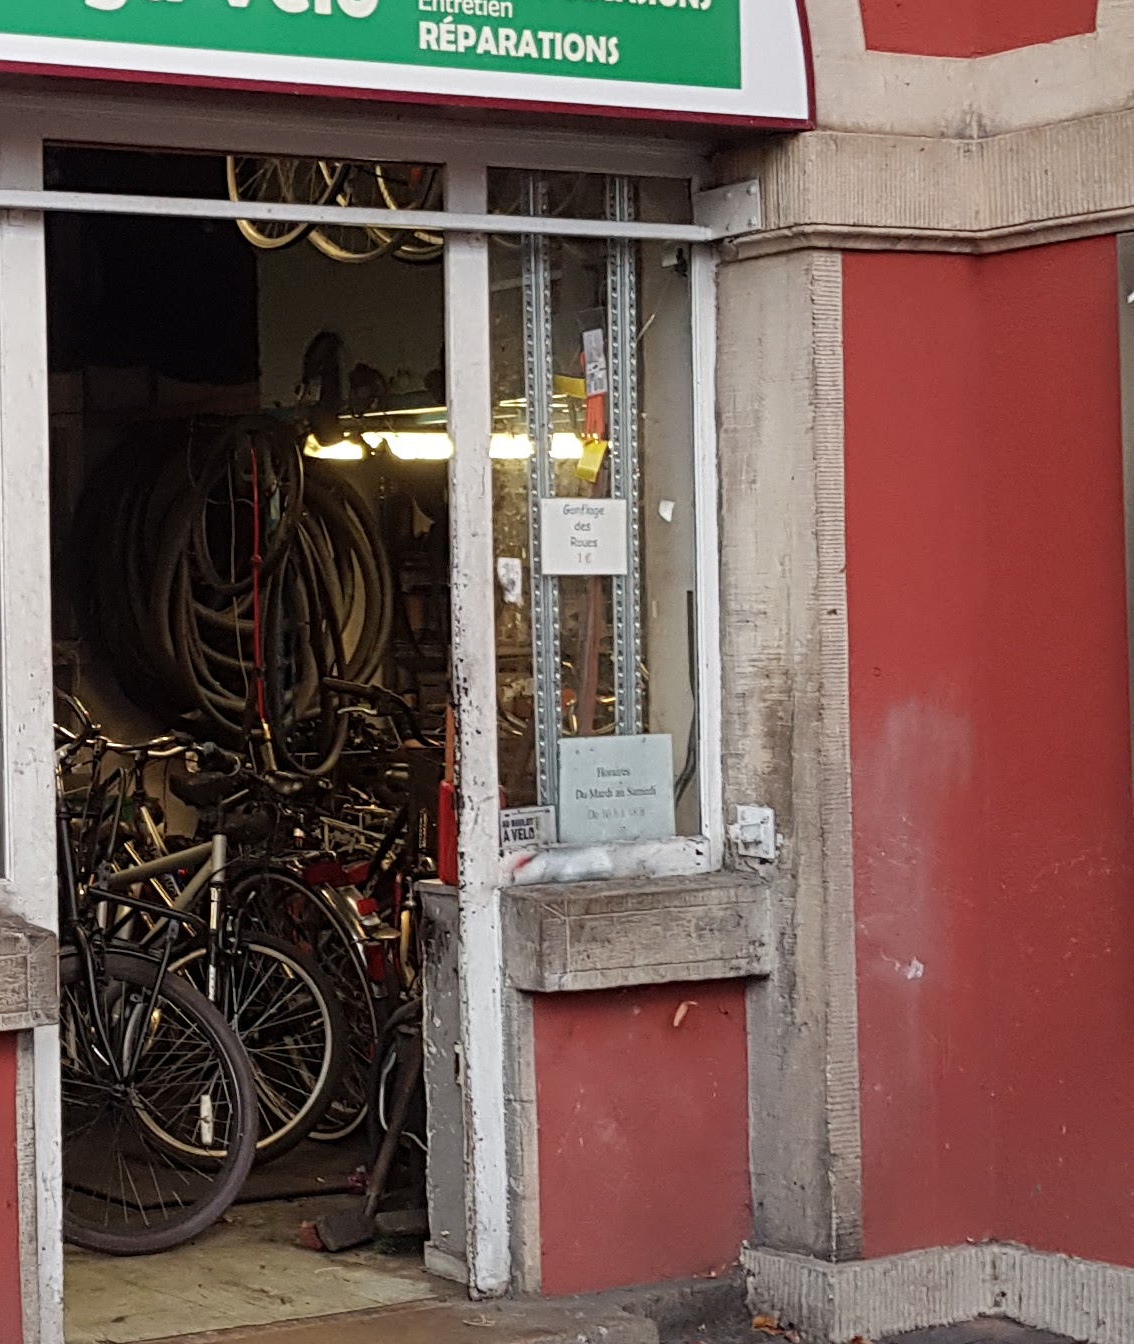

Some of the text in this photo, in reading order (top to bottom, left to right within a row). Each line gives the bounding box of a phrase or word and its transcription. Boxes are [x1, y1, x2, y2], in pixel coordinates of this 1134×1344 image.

[418, 15, 620, 66] RÉPARATIONS
[573, 521, 591, 532] des
[570, 536, 598, 548] Roues
